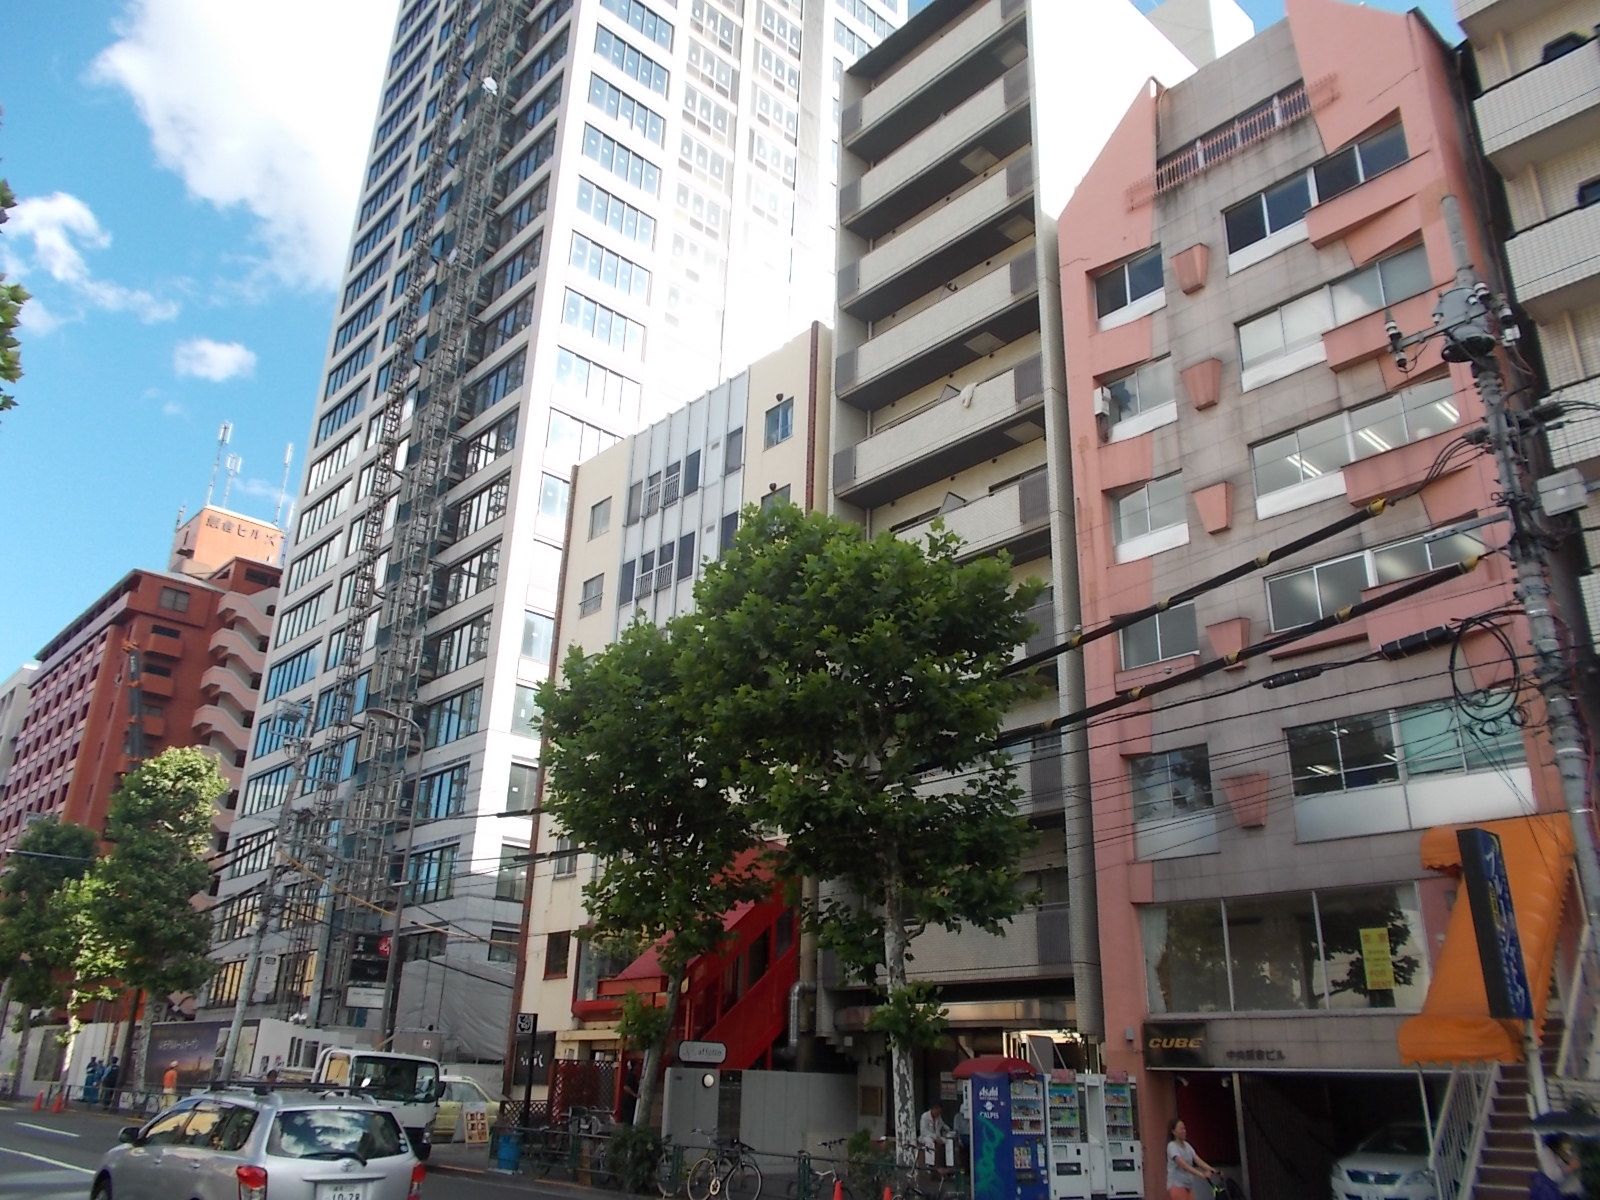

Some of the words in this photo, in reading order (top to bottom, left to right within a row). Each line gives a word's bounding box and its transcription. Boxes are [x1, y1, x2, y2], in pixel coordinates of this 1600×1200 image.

[1148, 1037, 1204, 1049] CUBE
[979, 1086, 999, 1097] Asahi
[979, 1111, 1000, 1120] CALPIS
